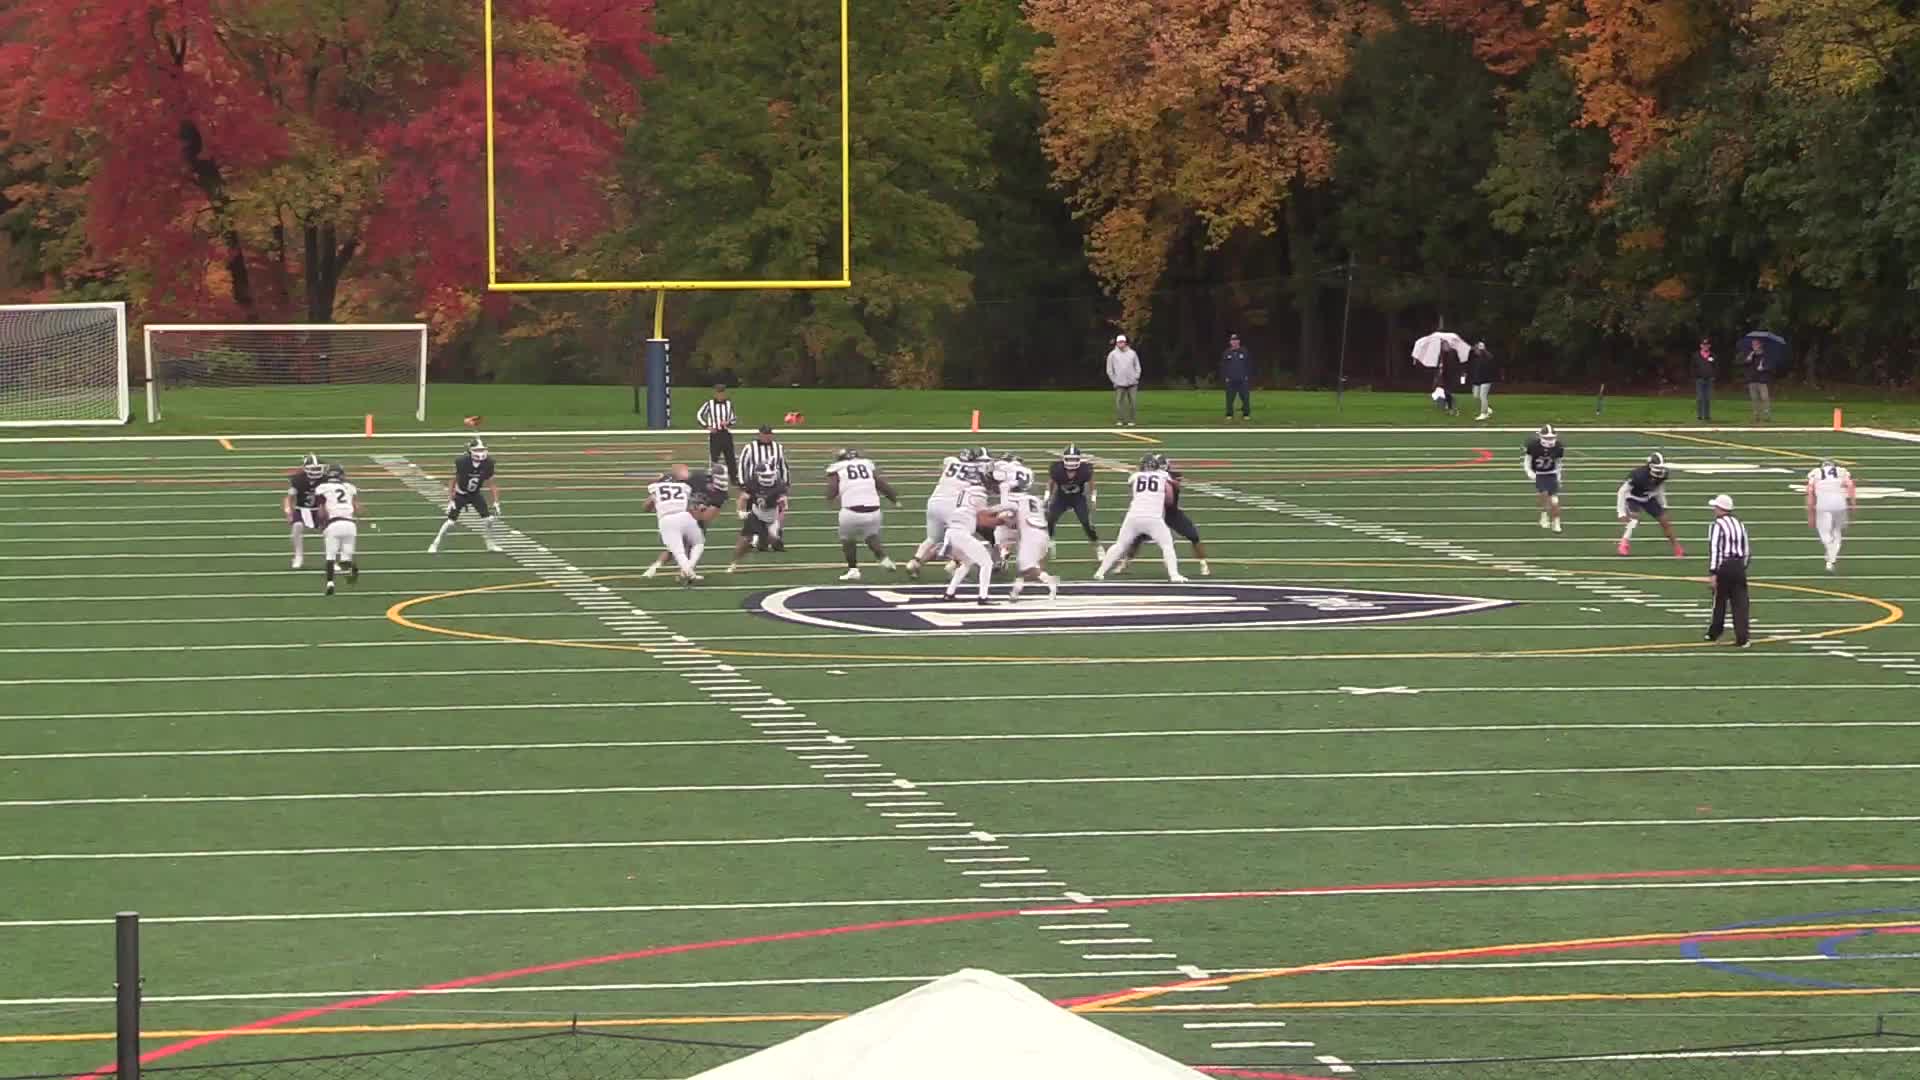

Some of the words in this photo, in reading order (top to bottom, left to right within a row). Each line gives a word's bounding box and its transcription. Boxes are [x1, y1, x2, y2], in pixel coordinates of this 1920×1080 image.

[846, 464, 870, 480] 68
[1821, 467, 1838, 480] 14
[468, 477, 480, 492] 6
[1136, 476, 1159, 492] 66
[335, 488, 347, 503] 2
[659, 486, 684, 501] 52
